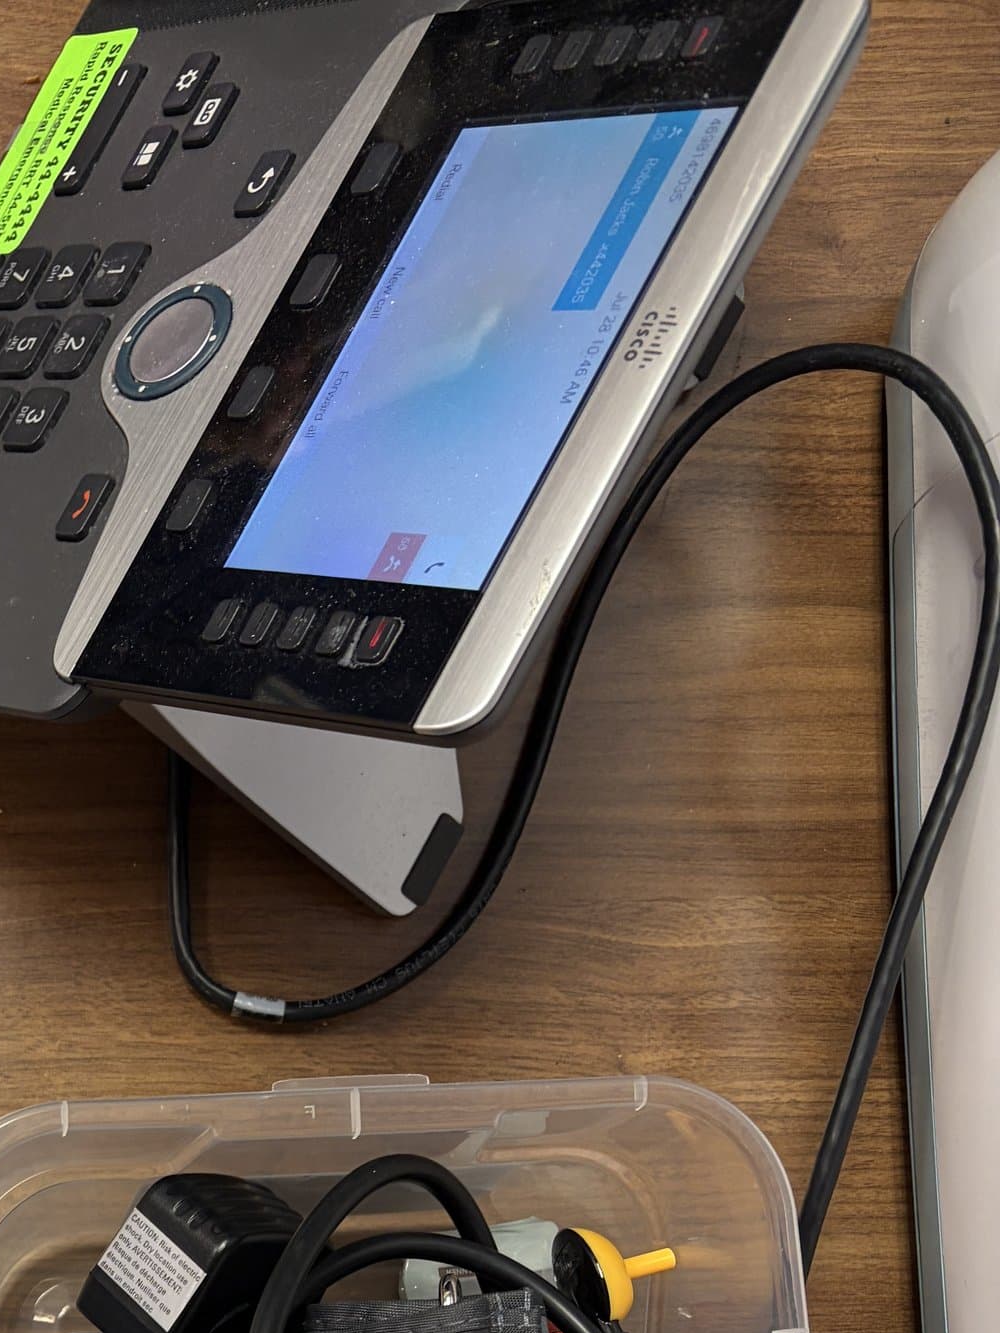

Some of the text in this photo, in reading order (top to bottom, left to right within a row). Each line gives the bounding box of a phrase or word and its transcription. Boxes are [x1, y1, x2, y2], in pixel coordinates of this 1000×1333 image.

[36, 78, 73, 137] Medical
[5, 43, 123, 242] SECURITY 44-4444
[13, 268, 31, 283] 7
[57, 266, 74, 281] 4
[17, 337, 37, 351] 5
[64, 337, 86, 351] 2
[560, 381, 582, 404] AM
[25, 409, 46, 424] 3
[131, 1214, 201, 1282] CAUTION: Risk of electric
